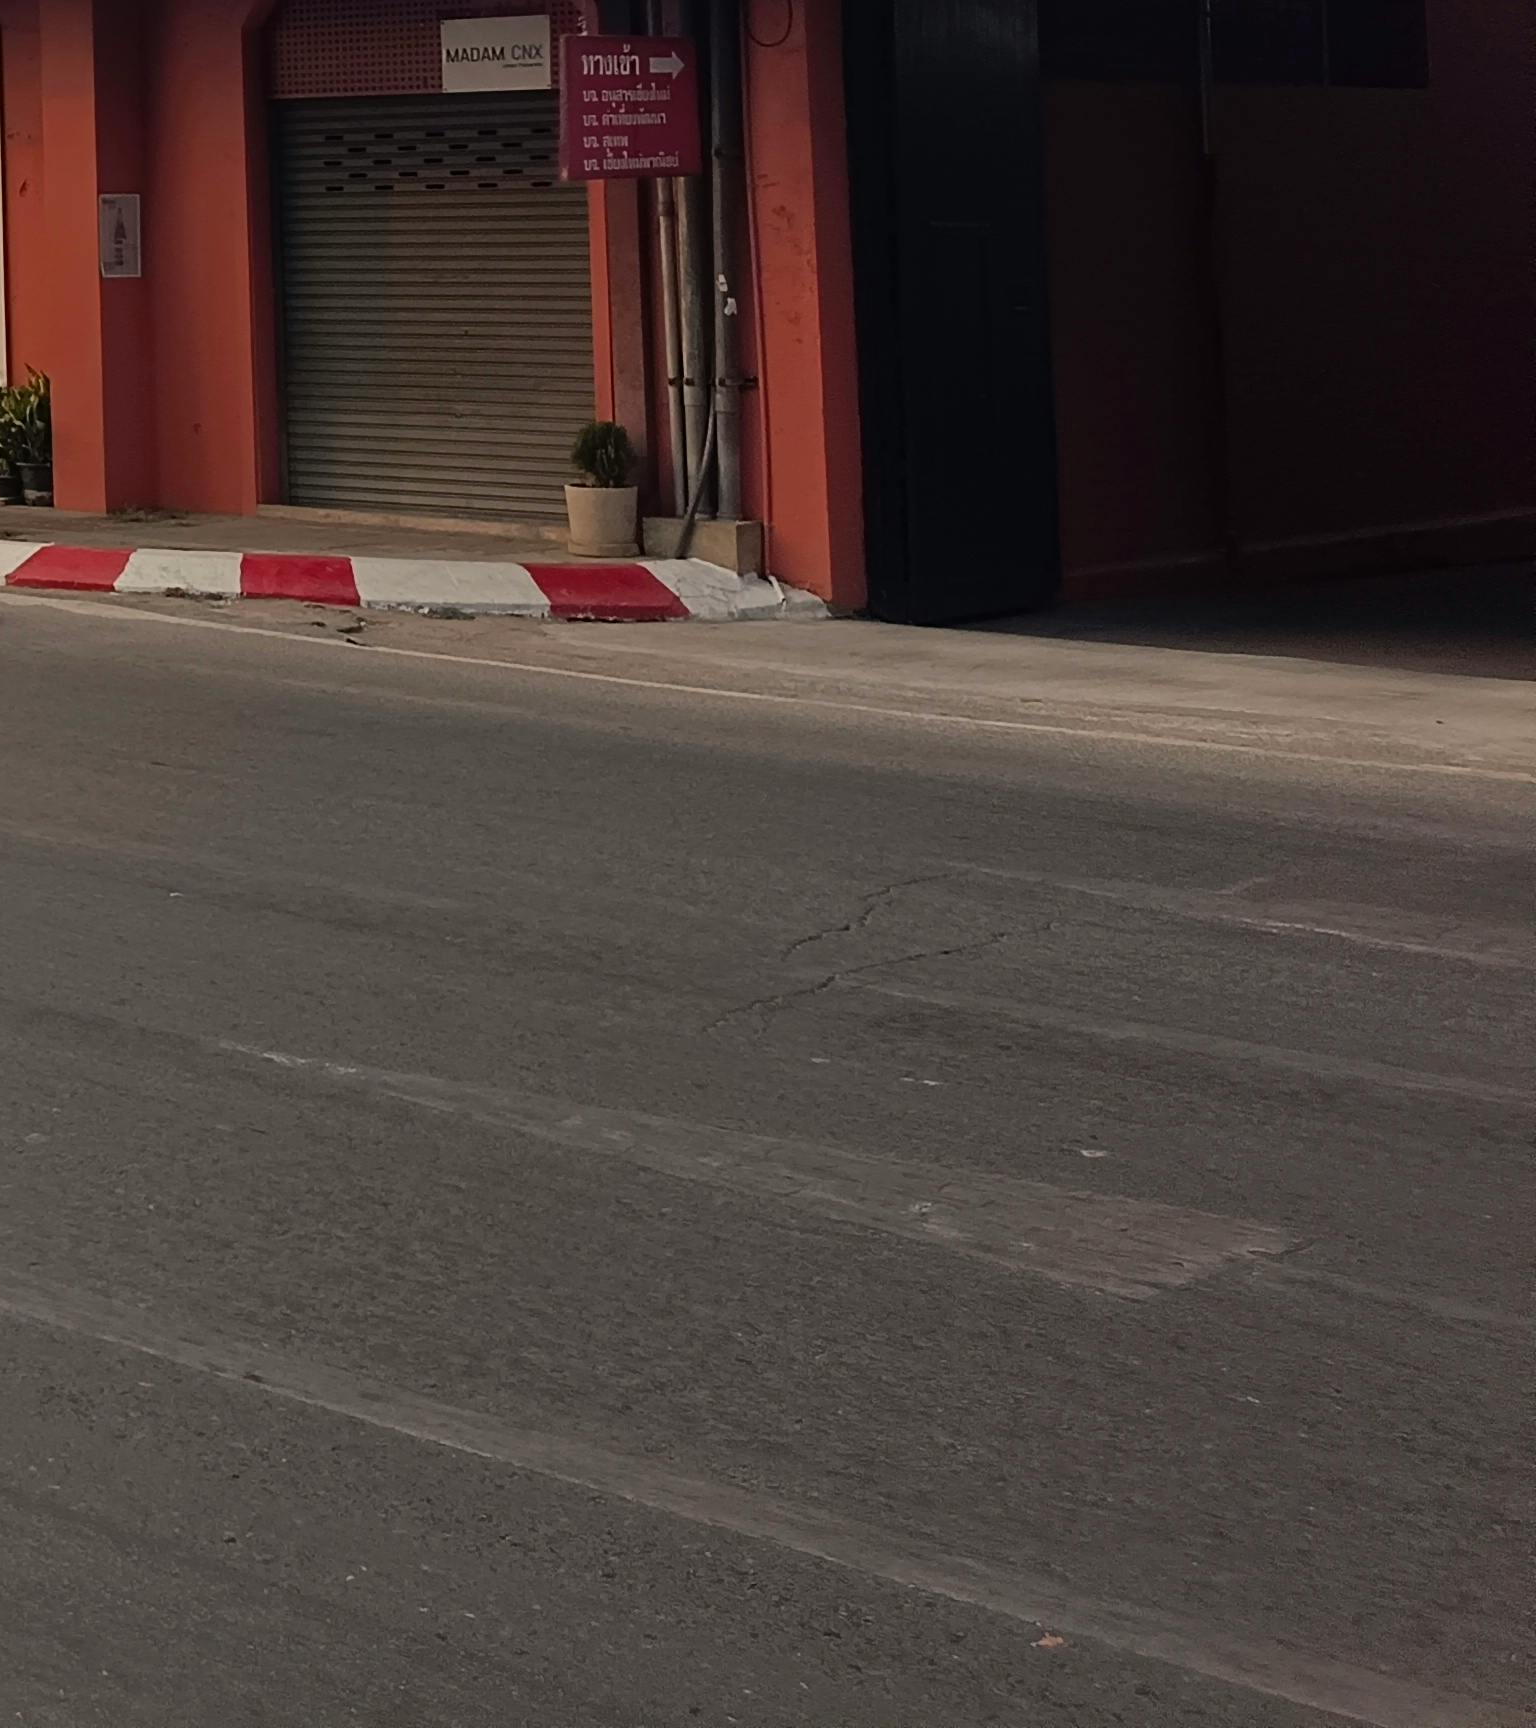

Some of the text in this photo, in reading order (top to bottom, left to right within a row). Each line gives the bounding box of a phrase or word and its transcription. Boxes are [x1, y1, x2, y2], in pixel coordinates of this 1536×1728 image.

[445, 44, 543, 64] MADAM CNX
[581, 43, 641, 76] ทางเข้า
